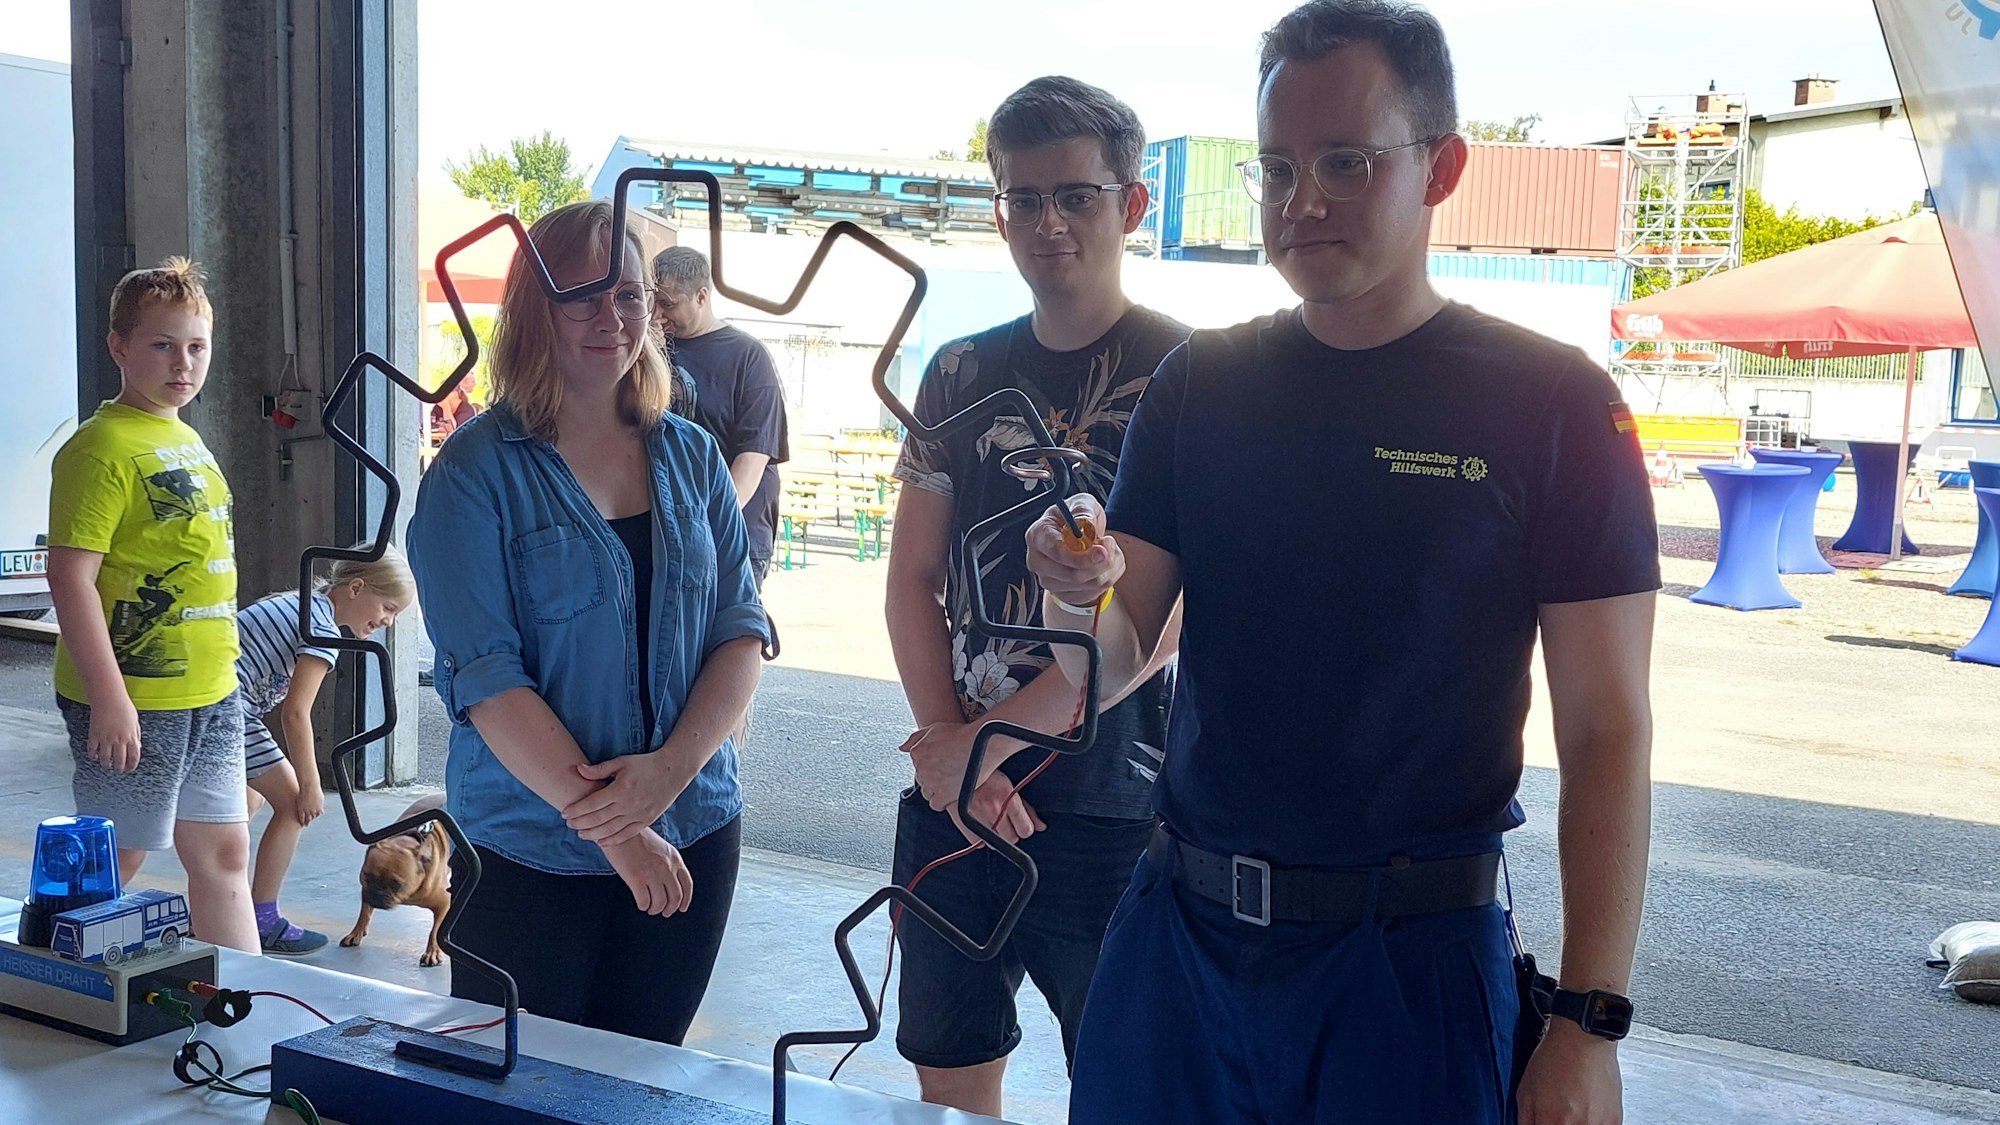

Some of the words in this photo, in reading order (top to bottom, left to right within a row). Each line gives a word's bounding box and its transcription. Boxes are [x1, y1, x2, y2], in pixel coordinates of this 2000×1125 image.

[1374, 447, 1458, 465] Technisches
[1390, 461, 1457, 478] Hilfswerk
[3, 554, 33, 573] LEV
[3, 955, 53, 980] HEISSER
[55, 967, 96, 992] DRAHT
